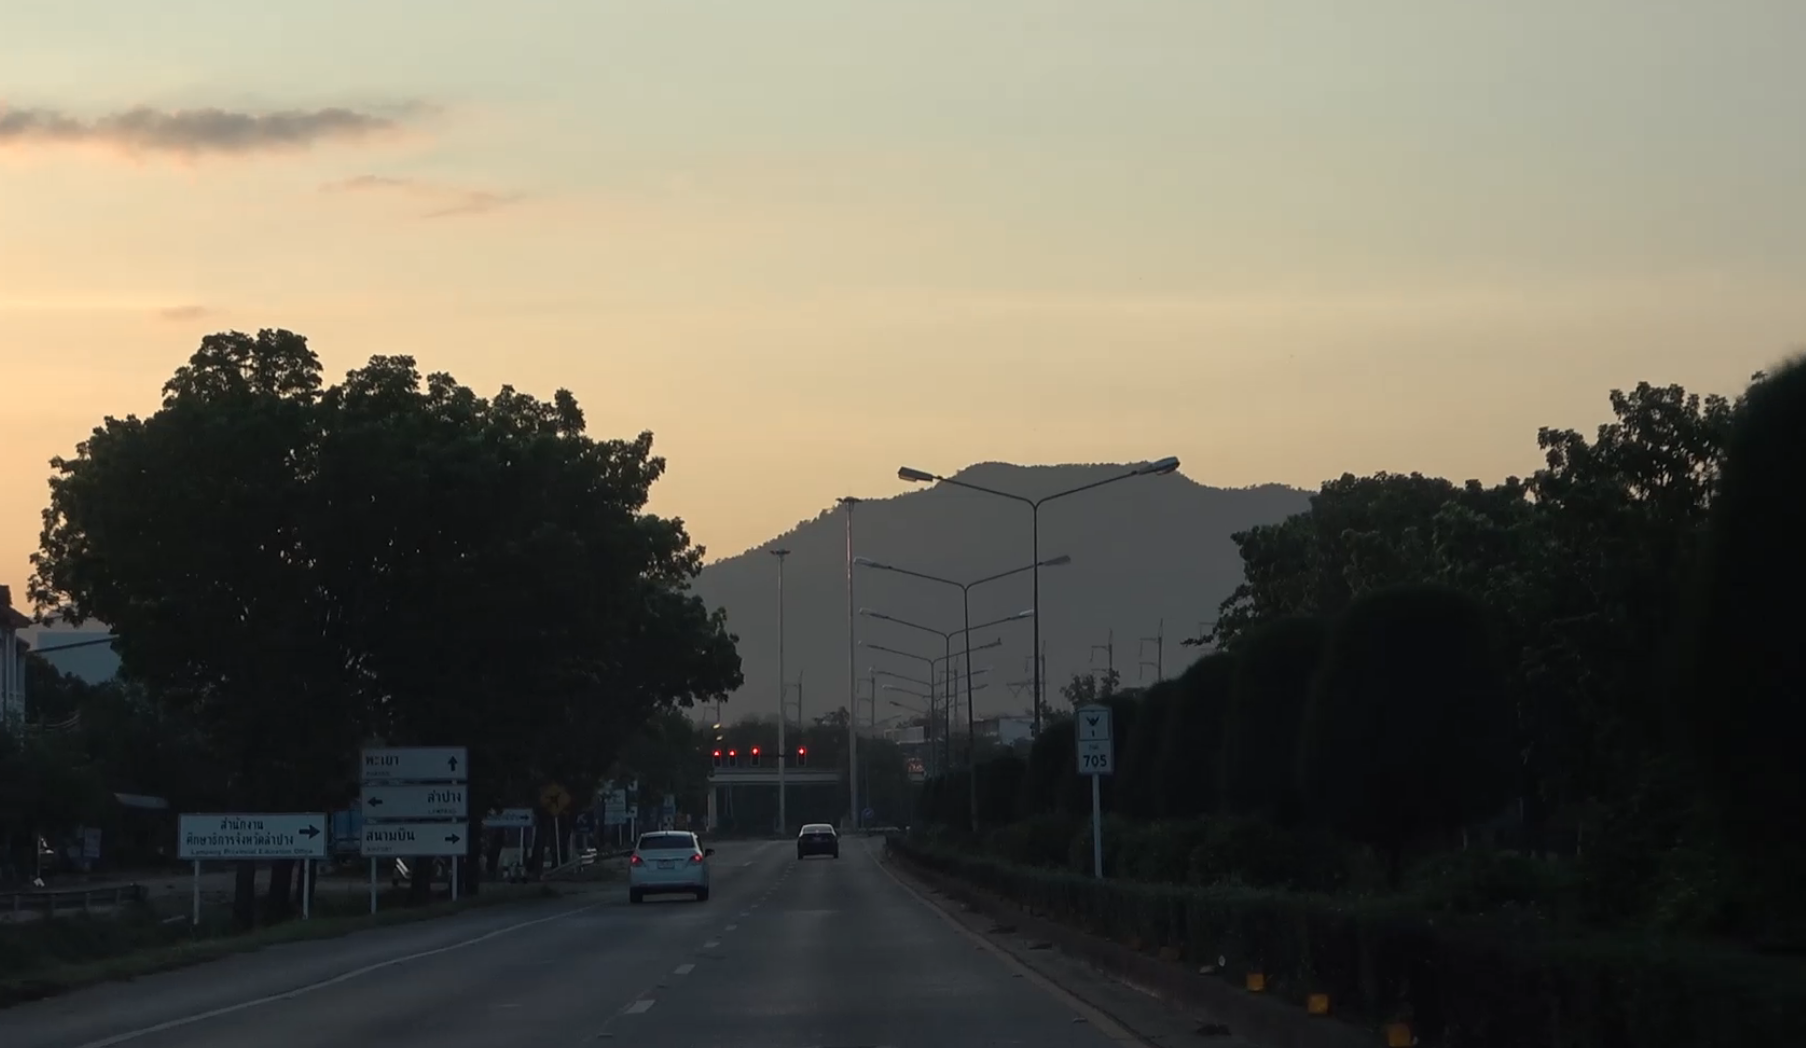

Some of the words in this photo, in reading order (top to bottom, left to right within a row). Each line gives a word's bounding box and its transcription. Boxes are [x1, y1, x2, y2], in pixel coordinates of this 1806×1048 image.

[366, 755, 399, 766] พะเยา
[1083, 754, 1107, 768] 705
[427, 789, 461, 803] ลำปาง
[220, 816, 264, 830] สำนักงาน
[186, 832, 294, 845] ศึกษาธิการจังหวัดลำปาง
[366, 826, 415, 841] สนามบิน
